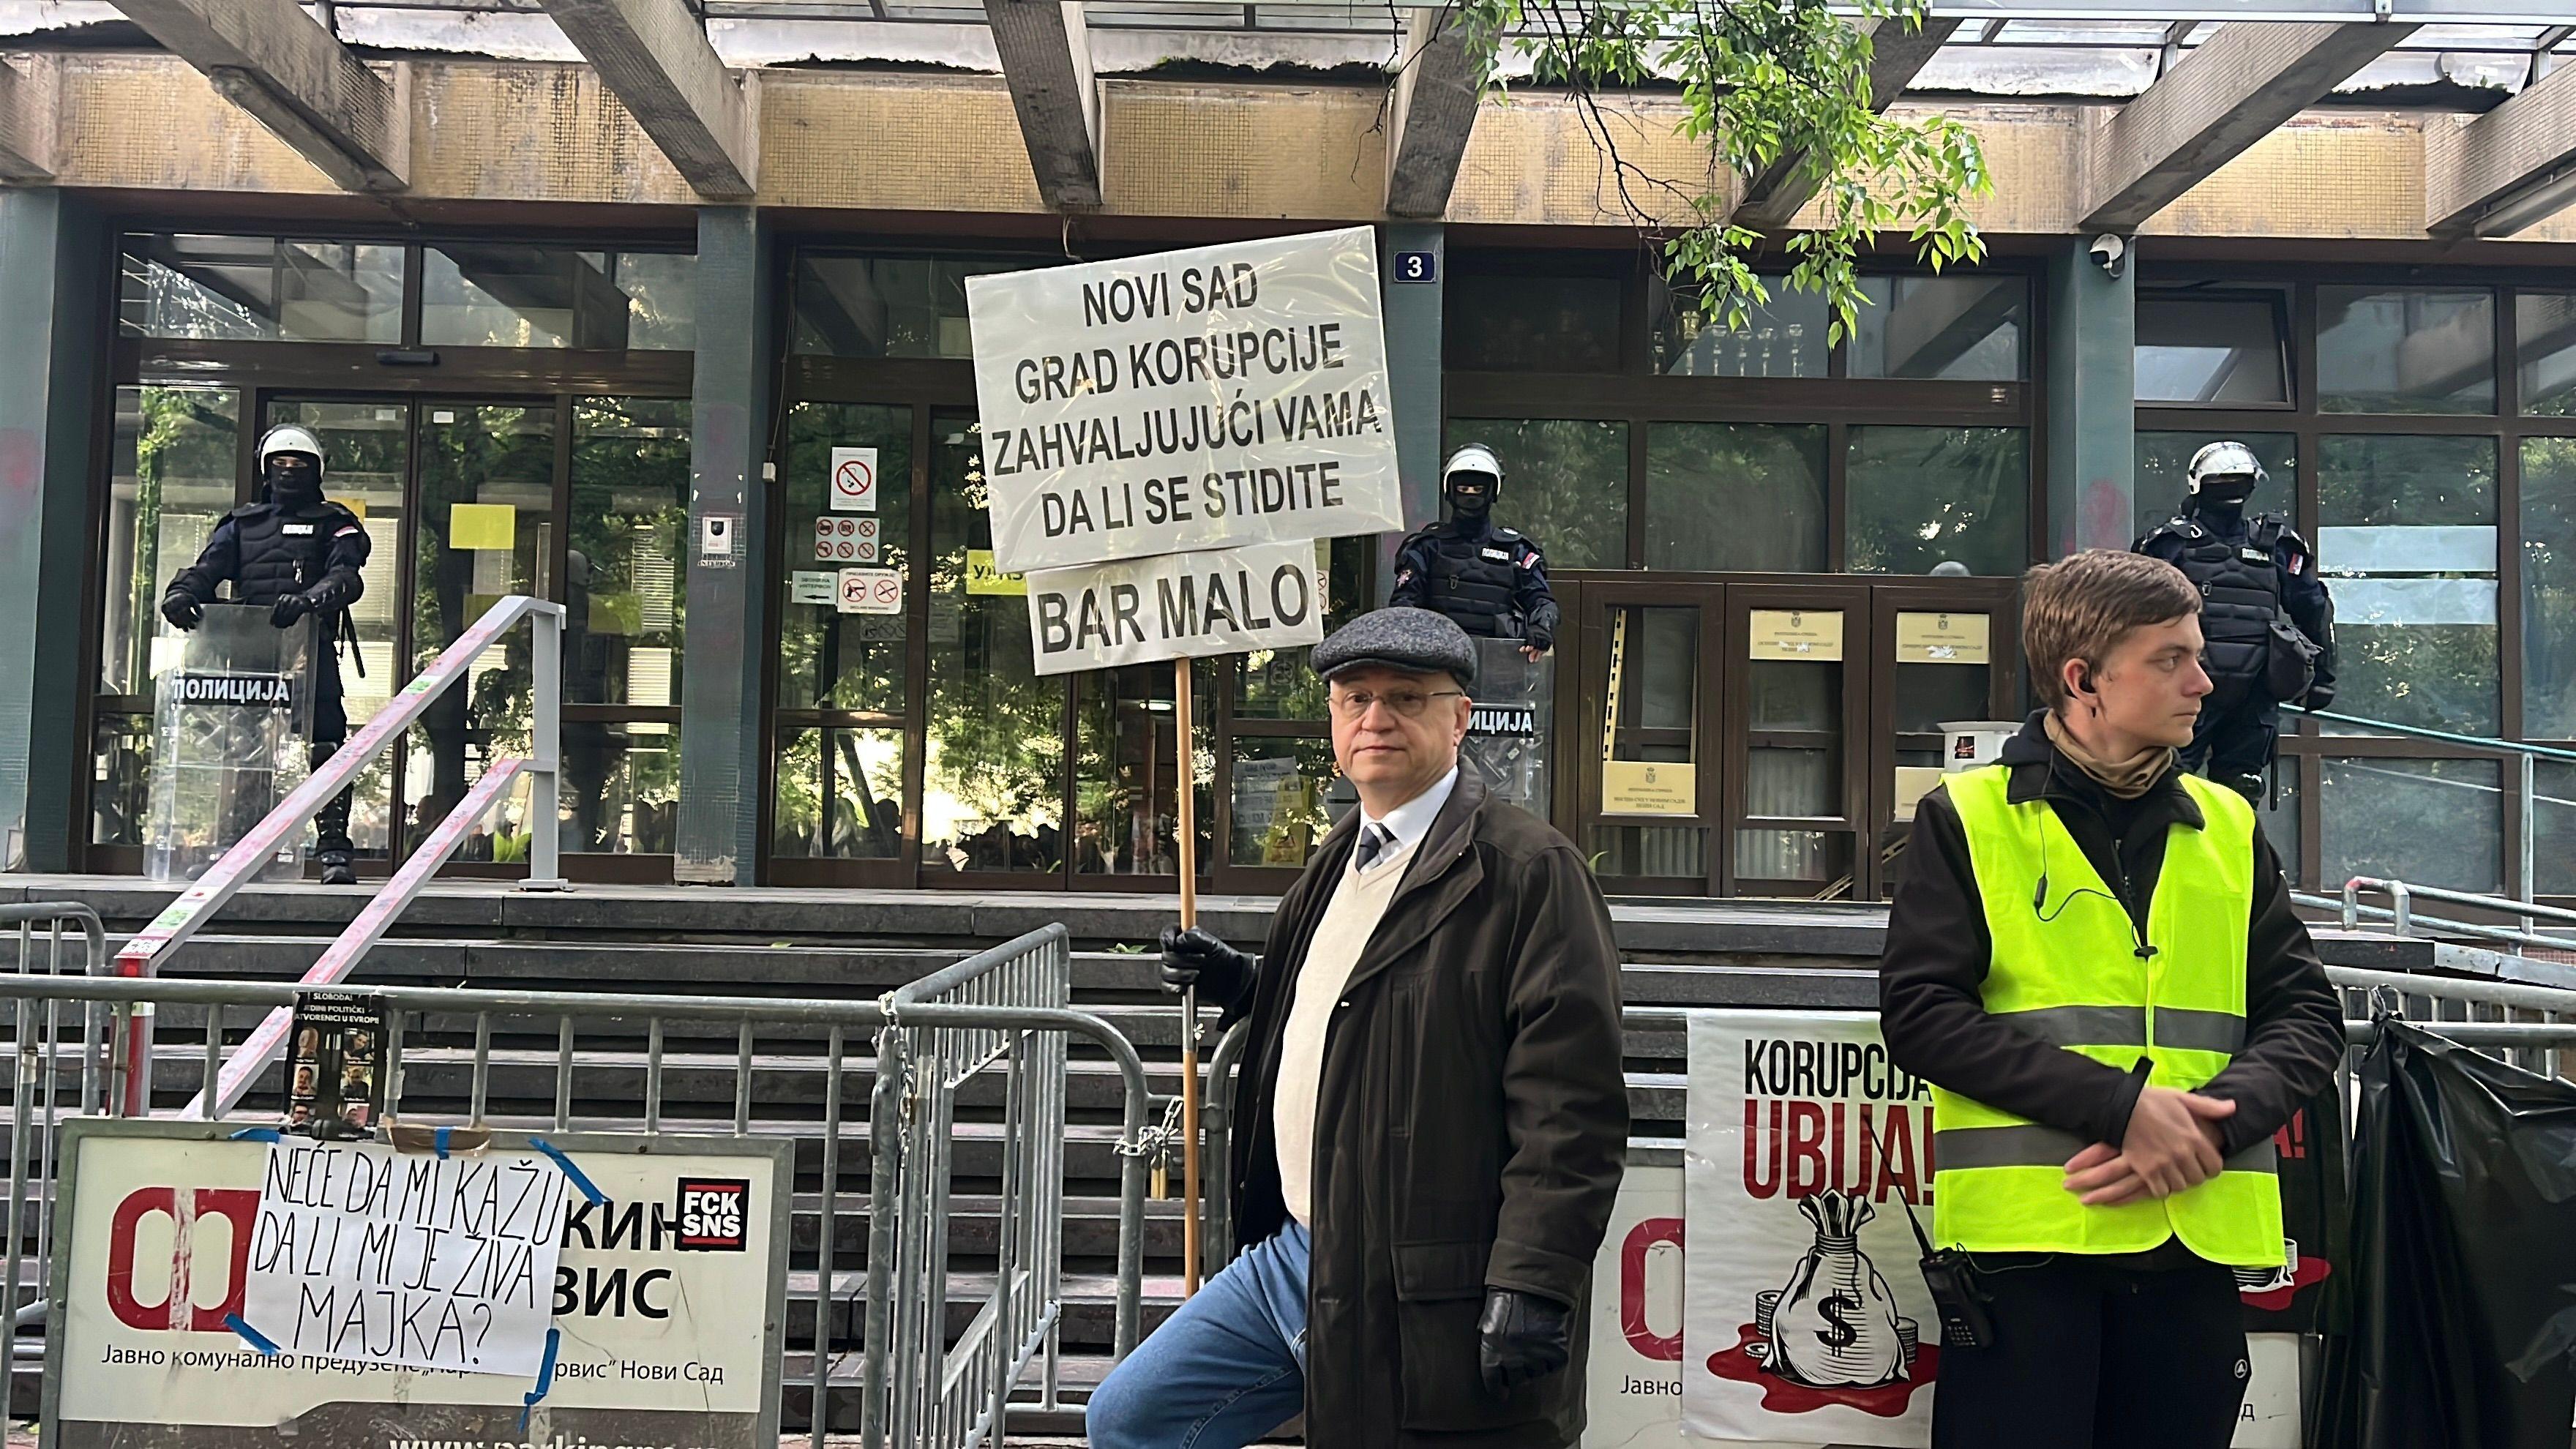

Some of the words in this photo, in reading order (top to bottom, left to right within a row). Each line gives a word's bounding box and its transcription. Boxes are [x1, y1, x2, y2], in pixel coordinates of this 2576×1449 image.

[1082, 272, 1170, 327] NOVI
[1181, 262, 1258, 315] SAD
[1407, 256, 1423, 277] 3
[1015, 348, 1118, 405] GRAD
[1128, 323, 1344, 389] KORUPCIJE
[992, 389, 1265, 476] ZAHVALJUJUĆI
[1273, 389, 1382, 442] VAMA
[1042, 487, 1095, 538] DA
[1102, 484, 1134, 530] LI
[1144, 476, 1193, 525] SE
[1203, 461, 1344, 519] STIDITE
[1038, 582, 1146, 654] BAR
[1157, 564, 1309, 640] MALO
[173, 678, 290, 704] ПОЛИЦИЈА
[1467, 711, 1533, 735] ИЦИЈА
[295, 1013, 341, 1022] ATVORENICI
[1742, 1100, 1934, 1206] UBIJA!
[266, 1142, 342, 1208] NEĆE
[345, 1152, 392, 1218] DA
[399, 1159, 440, 1225] MI
[449, 1159, 566, 1246] KAŽU
[684, 1191, 741, 1215] FCK
[682, 1213, 741, 1238] SNS
[255, 1211, 295, 1274] DA
[304, 1216, 341, 1276] LI
[356, 1221, 398, 1285] MI
[403, 1226, 449, 1292] JE
[452, 1232, 533, 1309] ŽIVA
[551, 1266, 673, 1319] ВИС
[293, 1282, 492, 1365] MAJKA?
[102, 1344, 165, 1365] Јавно
[171, 1350, 294, 1374] комунално
[555, 1360, 616, 1382] рвис”
[621, 1360, 677, 1380] Нови
[684, 1362, 724, 1385] Сад
[1620, 1374, 1682, 1396] Јавно
